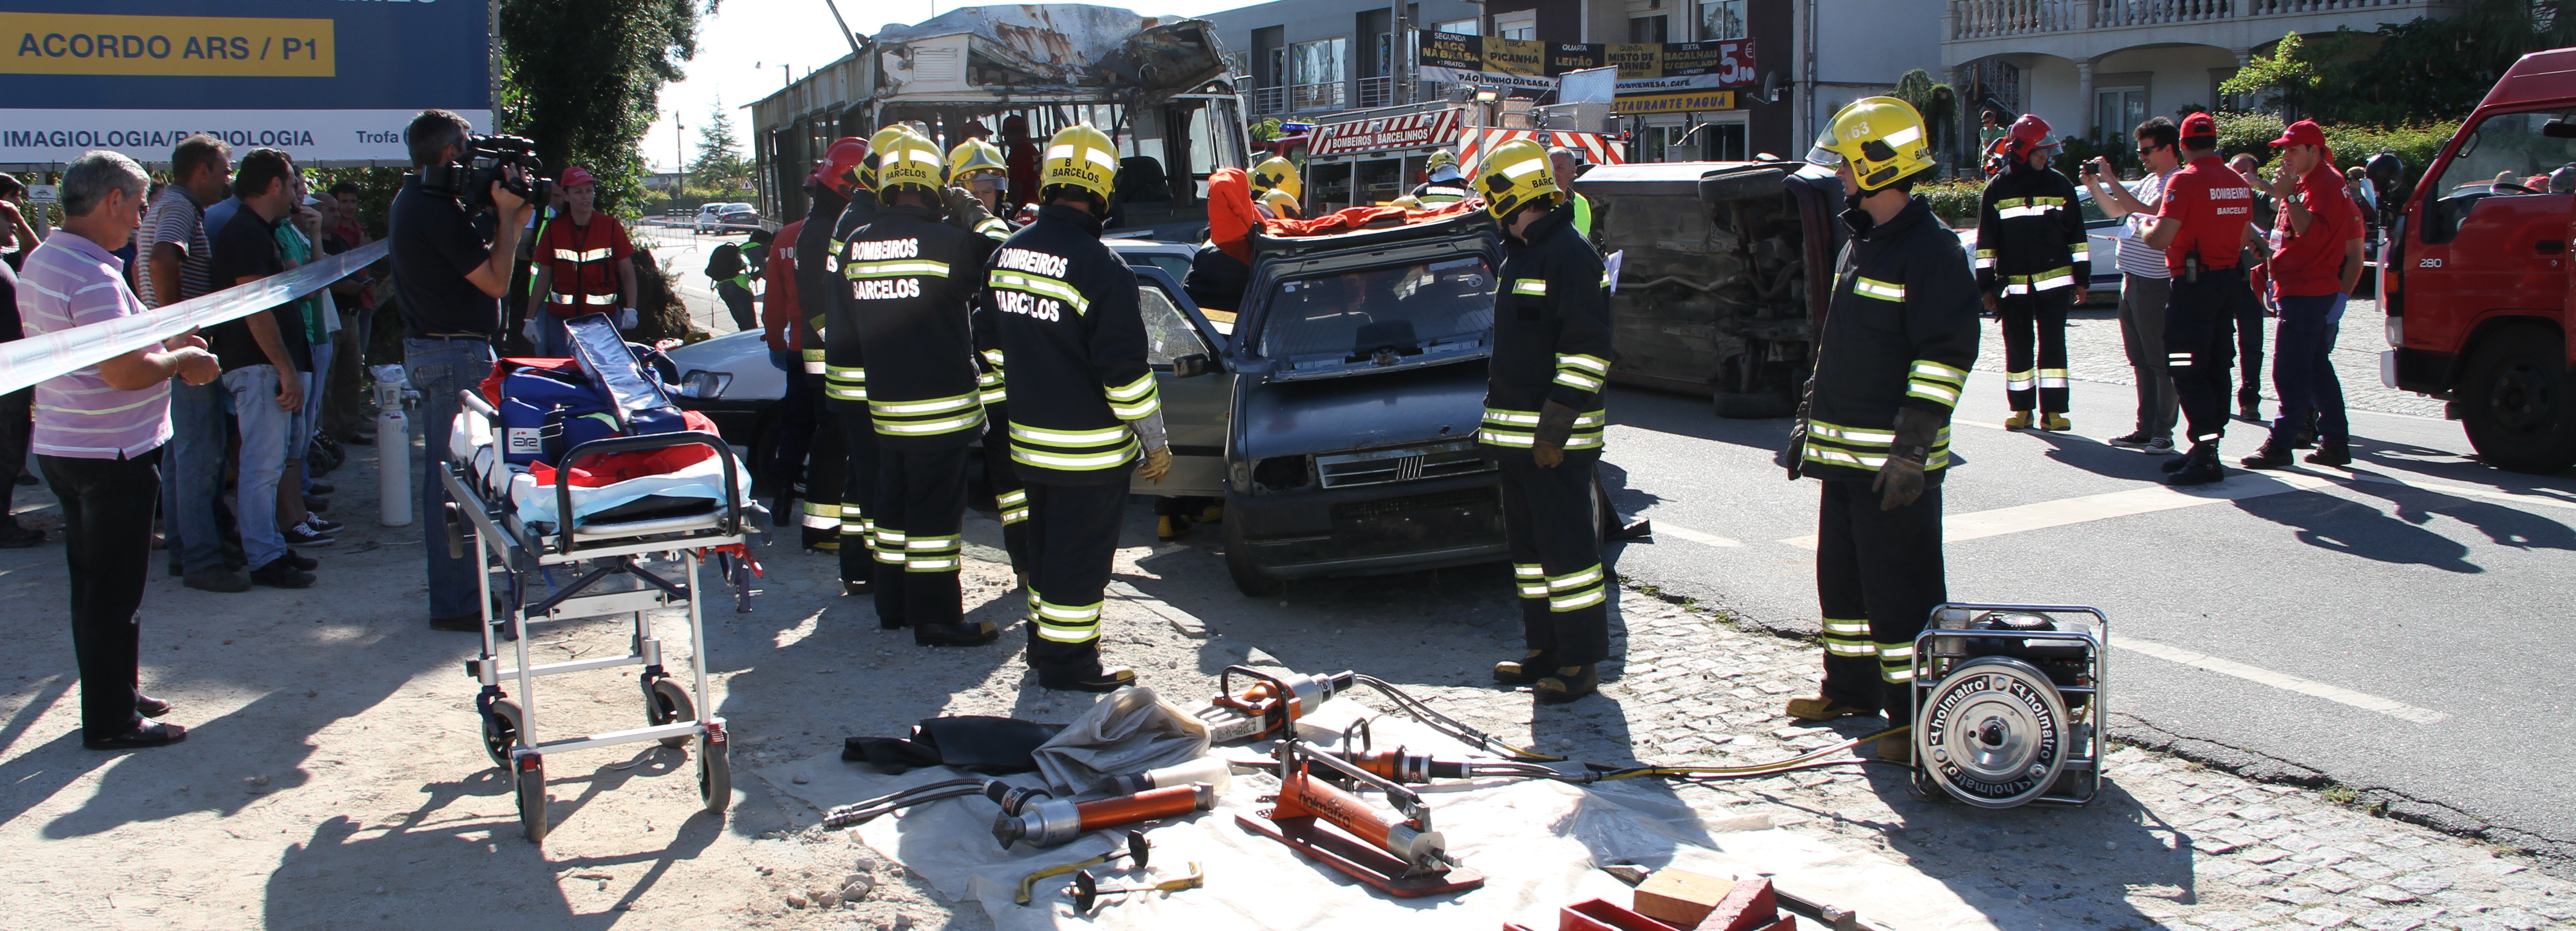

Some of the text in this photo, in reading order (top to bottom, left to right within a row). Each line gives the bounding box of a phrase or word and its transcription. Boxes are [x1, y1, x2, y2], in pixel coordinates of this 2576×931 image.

[1434, 32, 1466, 42] SEGUNDA
[18, 33, 317, 60] ACORDO ARS / P1
[1434, 41, 1465, 52] NACO
[1505, 40, 1527, 49] TERÇA
[1745, 43, 1753, 58] €
[1423, 48, 1480, 62] NA BRASA
[1490, 52, 1539, 64] PICANHA
[1555, 56, 1593, 67] LEITÃO
[1608, 52, 1654, 62] MISTO DE
[1664, 50, 1717, 61] BACALHAU
[1459, 73, 1479, 82] PÃO
[1484, 76, 1512, 84] VINHO
[1610, 92, 1725, 112] STAURANTE PAGUÁ
[4, 130, 315, 147] IMAGIOLOGIA/RDIOLOGIA
[356, 131, 399, 144] Trofa
[1843, 121, 1870, 142] 163
[1332, 129, 1428, 149] BOMBEIROS BARCELINHOS
[1064, 158, 1092, 170] B V
[1479, 159, 1491, 174] 65
[886, 170, 927, 181] BARCELOS
[1052, 168, 1100, 183] BARCELOS
[1426, 186, 1465, 196] BOMBEIROS
[2217, 207, 2248, 215] BARCELOS
[851, 237, 918, 260] BOMBEIROS
[997, 248, 1068, 279] BOMBEIROS
[2419, 258, 2442, 268] 280
[853, 278, 920, 300] BARCELOS
[1931, 680, 1985, 729] holmatro
[2024, 692, 2055, 759] holmatro
[1947, 767, 2015, 796] holmatro
[1298, 789, 1352, 829] holmatro
